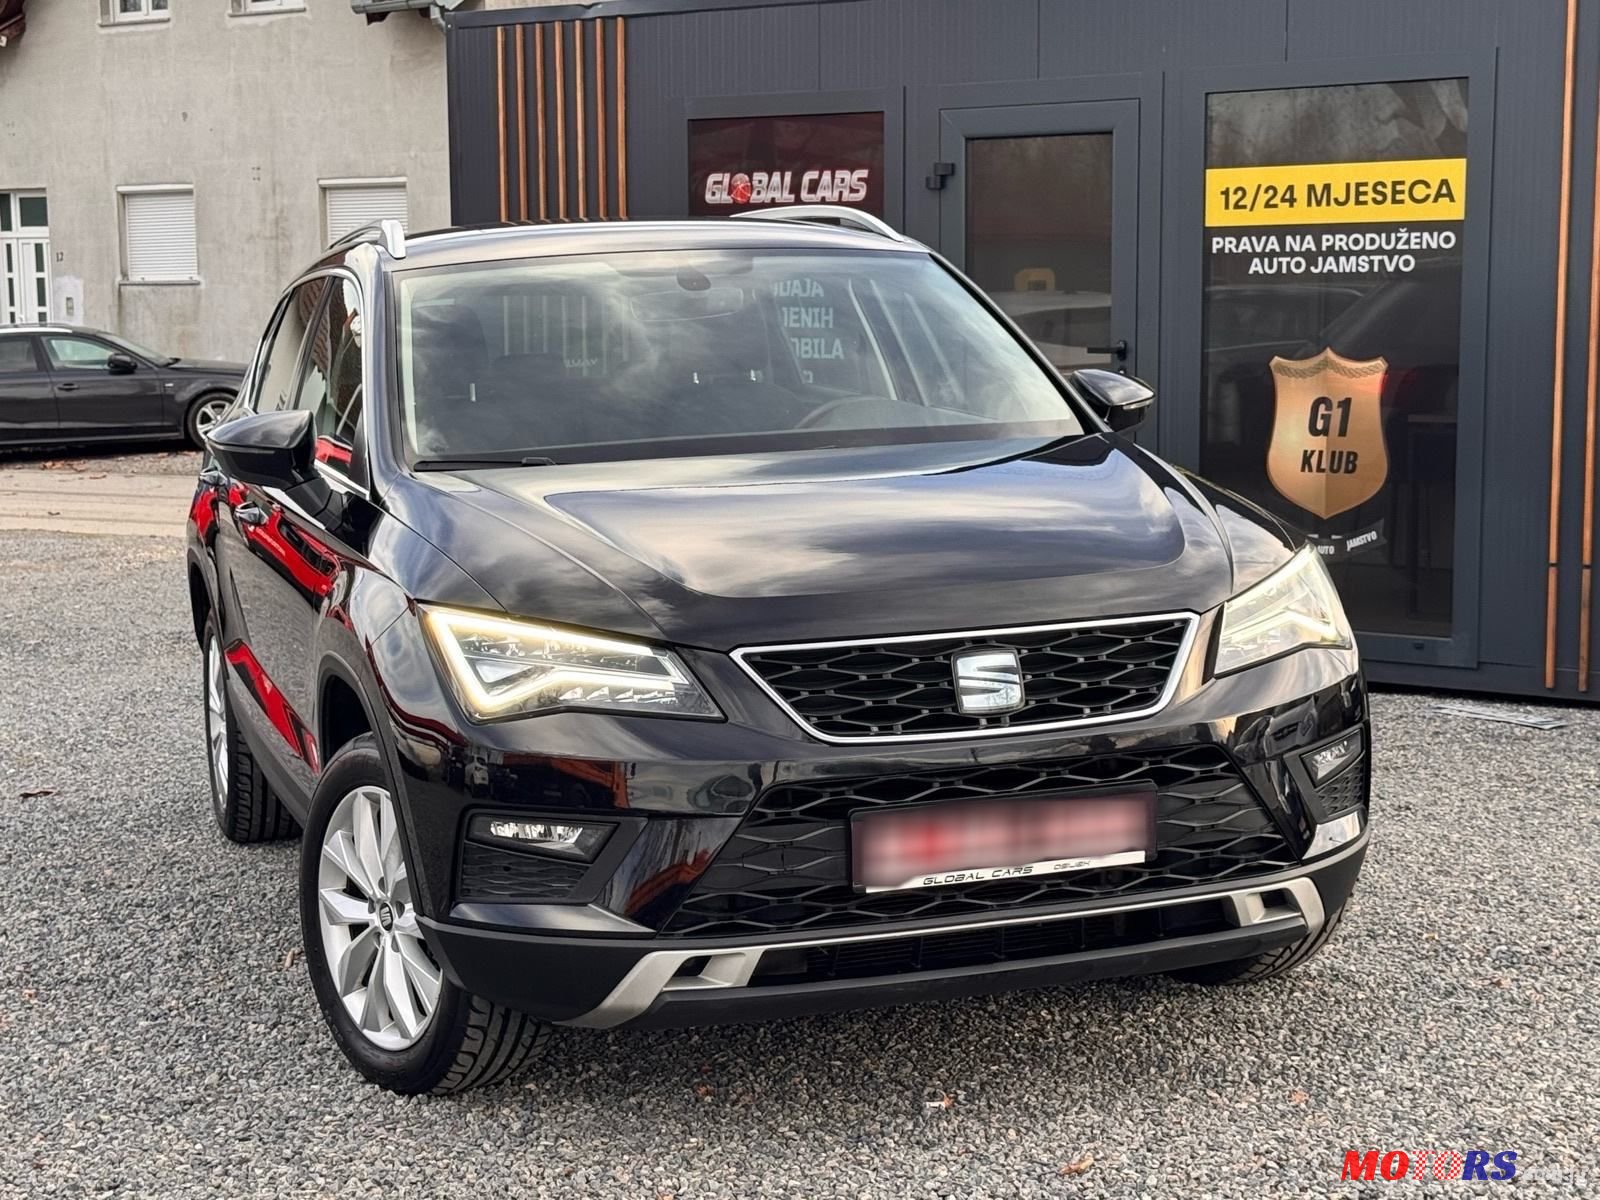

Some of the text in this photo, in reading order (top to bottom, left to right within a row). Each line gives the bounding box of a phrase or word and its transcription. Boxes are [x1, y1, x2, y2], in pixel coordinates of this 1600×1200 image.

[704, 170, 869, 203] GLOBAL CARS
[1220, 179, 1456, 212] 12/24 MJESECA
[1211, 228, 1457, 253] PRAVA NA PRODUŽENO
[1248, 255, 1416, 275] AUTO JAMSTVO
[1308, 396, 1352, 438] G1
[1300, 449, 1359, 475] KLUB
[1346, 531, 1377, 552] JAMSTVO
[923, 872, 984, 886] GLOBAL
[991, 866, 1033, 878] CARS
